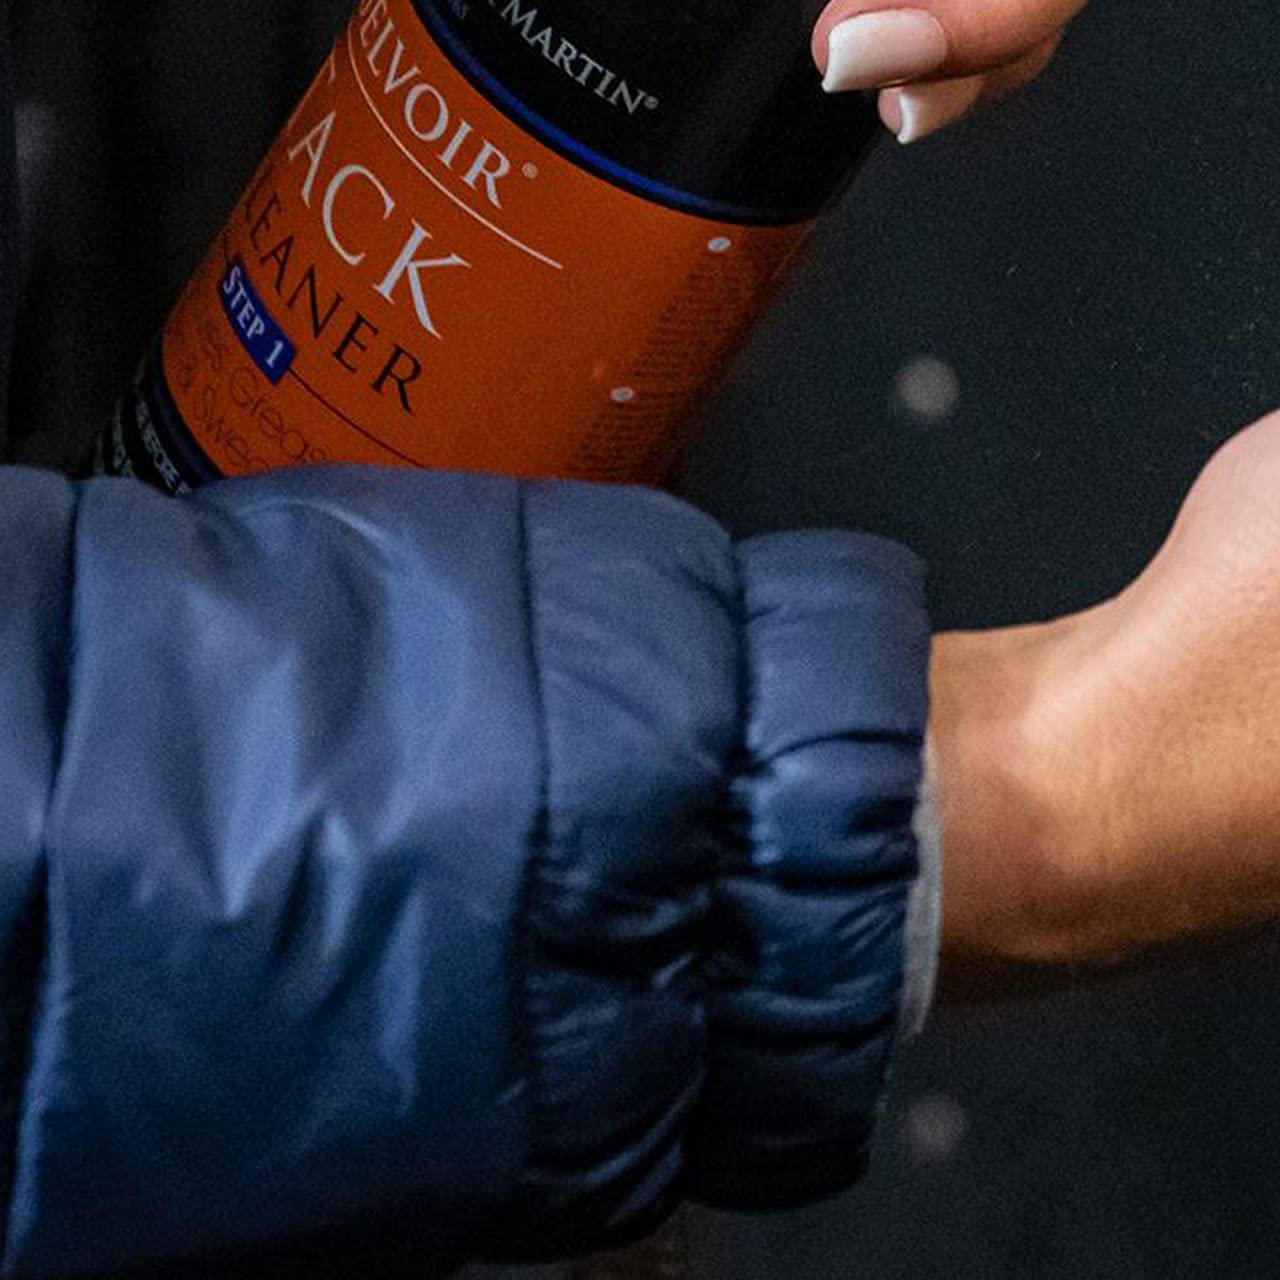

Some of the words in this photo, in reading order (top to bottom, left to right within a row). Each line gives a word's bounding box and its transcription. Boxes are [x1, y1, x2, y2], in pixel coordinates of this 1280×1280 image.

[222, 265, 265, 339] STEP
[264, 339, 284, 368] 1
[243, 170, 423, 415] LEANER
